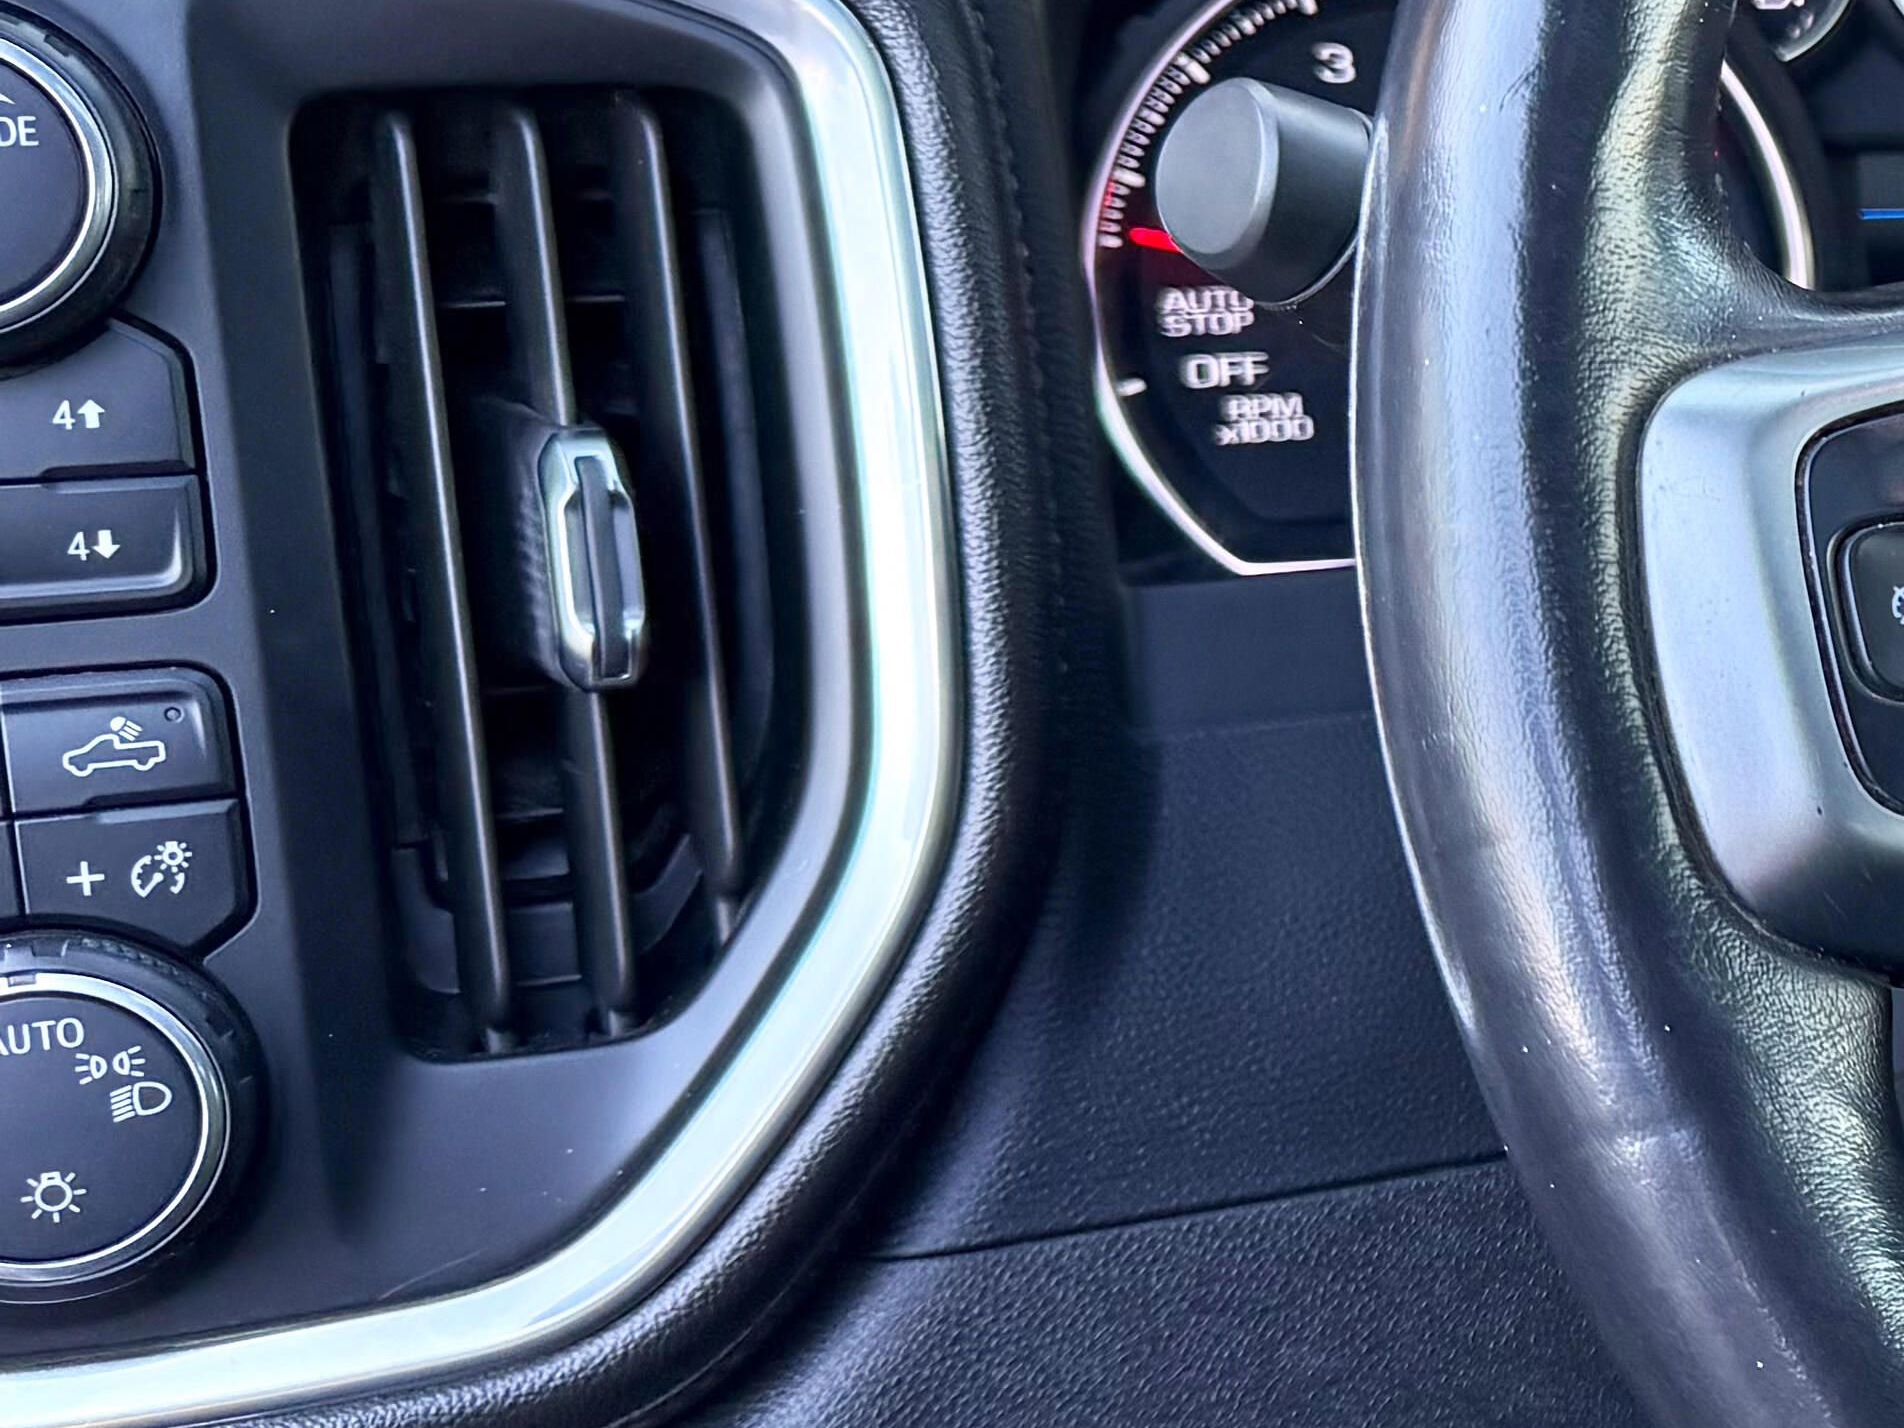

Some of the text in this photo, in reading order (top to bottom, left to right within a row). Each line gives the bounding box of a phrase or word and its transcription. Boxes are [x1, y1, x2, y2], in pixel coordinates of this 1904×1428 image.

[1312, 42, 1357, 84] 3
[1158, 311, 1255, 338] STOP
[1179, 351, 1270, 389] OFF
[52, 399, 76, 430] 4
[1221, 392, 1304, 423] RPM
[66, 531, 91, 561] 4
